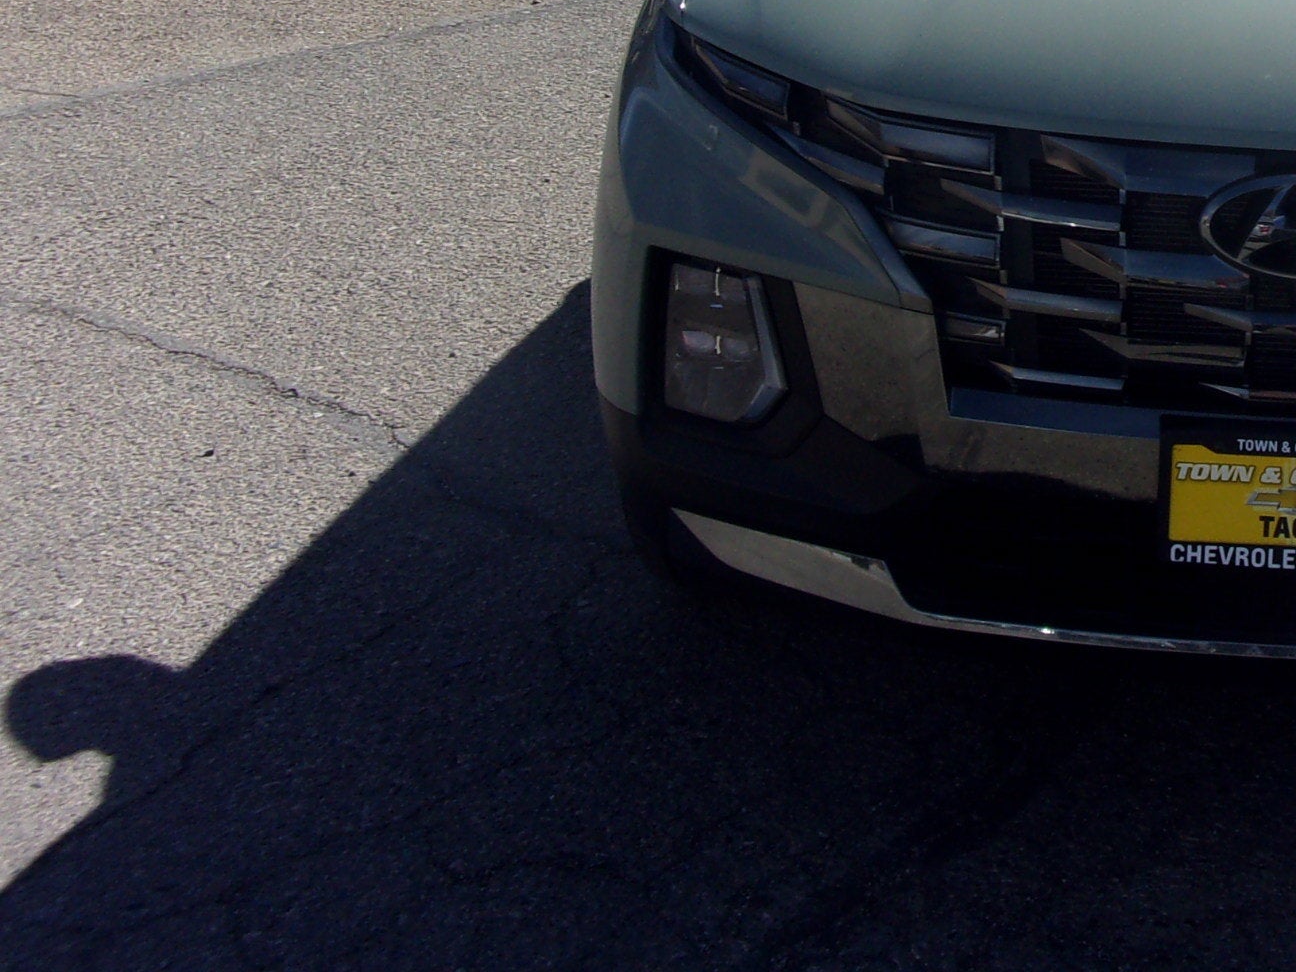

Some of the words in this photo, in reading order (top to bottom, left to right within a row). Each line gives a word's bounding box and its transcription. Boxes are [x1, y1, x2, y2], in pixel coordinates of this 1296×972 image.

[1237, 438, 1278, 453] TOWN
[1281, 441, 1291, 454] &
[1175, 462, 1255, 483] TOWN
[1260, 466, 1282, 484] &
